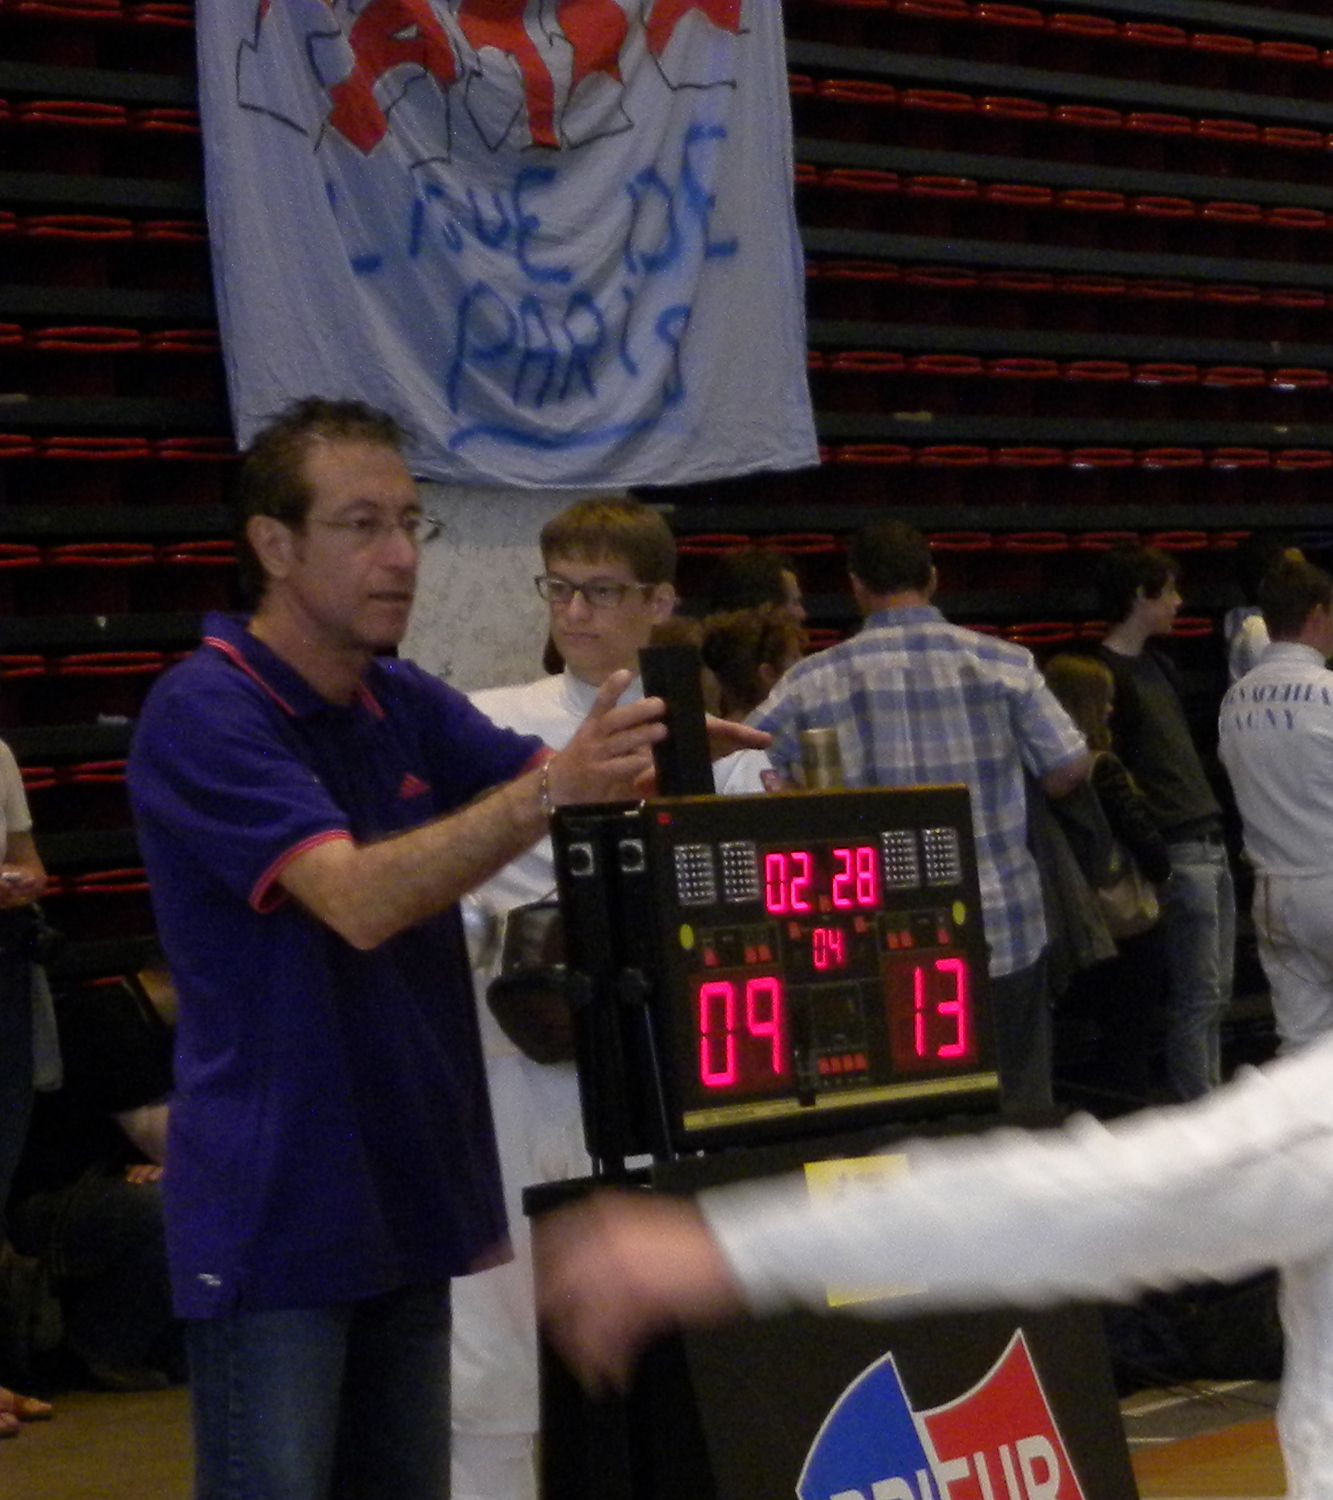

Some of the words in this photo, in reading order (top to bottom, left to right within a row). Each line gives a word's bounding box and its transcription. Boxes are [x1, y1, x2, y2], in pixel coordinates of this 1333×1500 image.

[624, 124, 739, 276] DE
[446, 280, 692, 414] PARIS
[765, 851, 813, 915] 02
[831, 846, 878, 910] 28
[813, 928, 845, 971] 04
[700, 976, 782, 1088] 09
[913, 958, 967, 1058] 13
